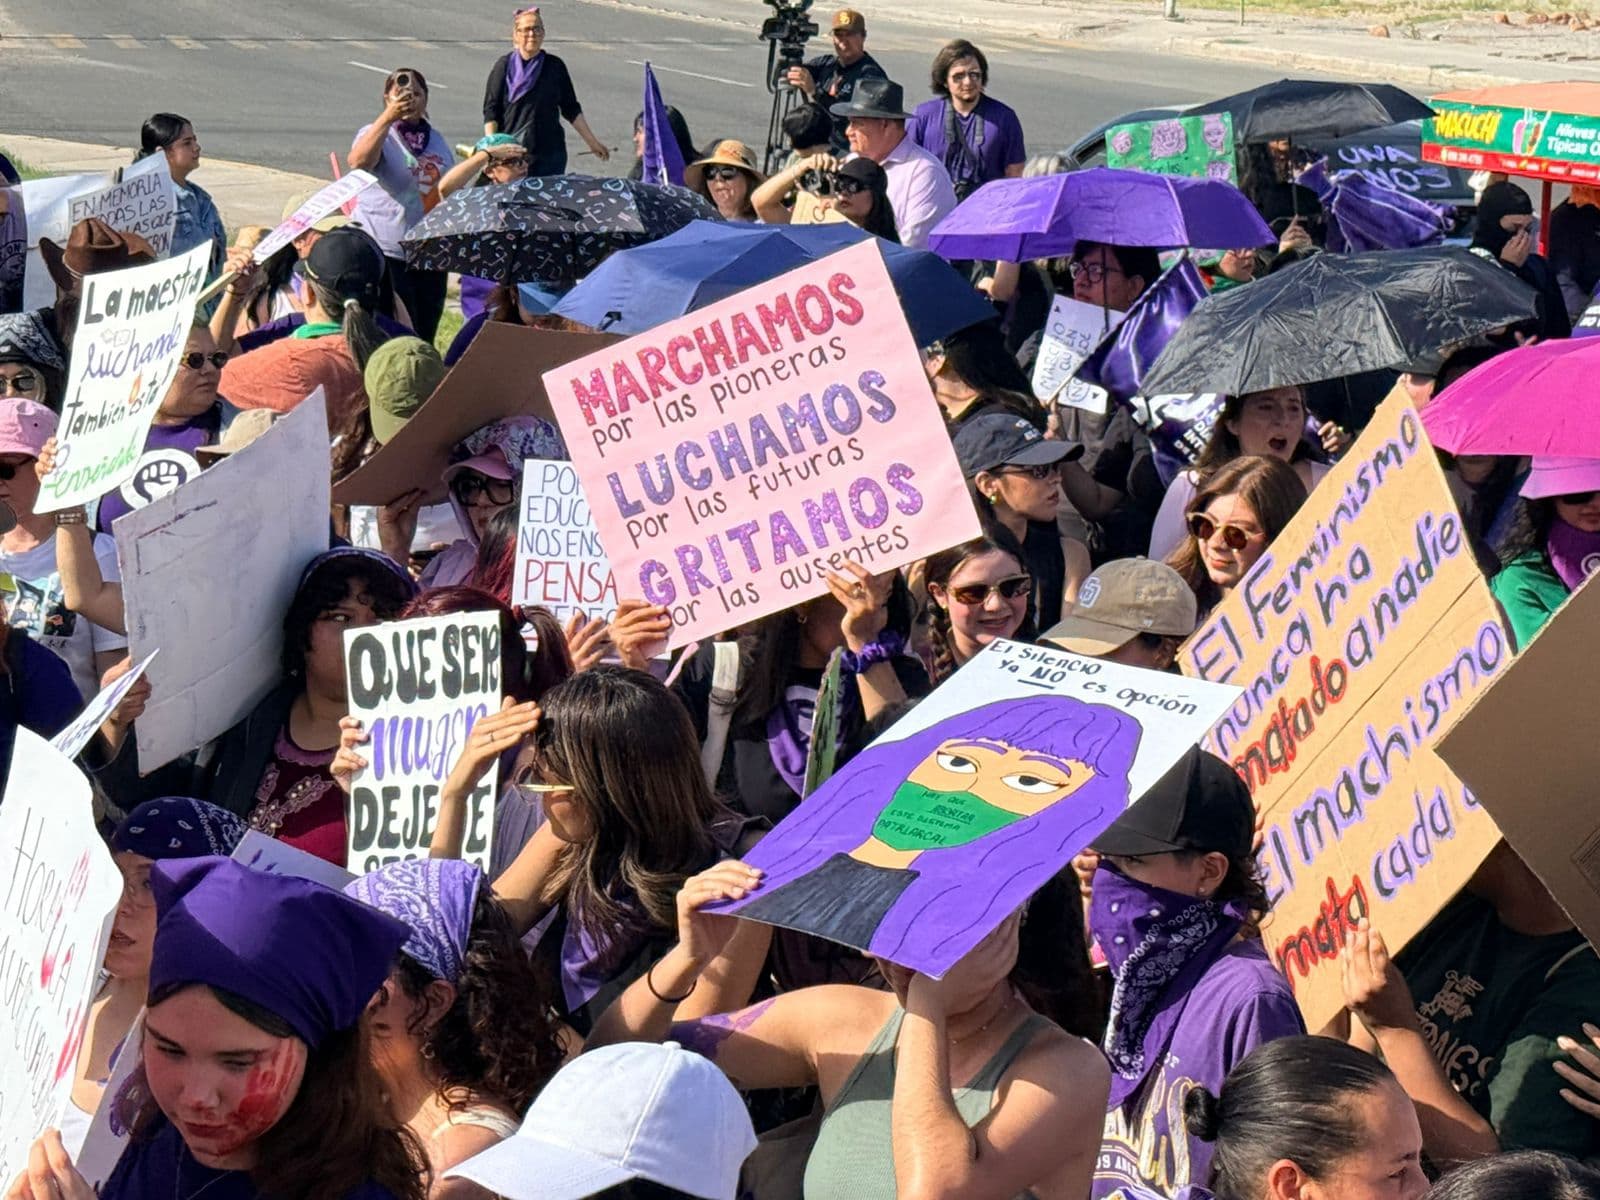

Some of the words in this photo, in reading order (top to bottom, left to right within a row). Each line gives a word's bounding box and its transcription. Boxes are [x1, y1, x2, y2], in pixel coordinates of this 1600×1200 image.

[73, 196, 96, 222] EN
[99, 173, 161, 210] MEMORIA
[1338, 144, 1418, 164] UNA
[139, 195, 167, 216] LAS
[84, 282, 122, 324] La
[127, 257, 203, 320] maestra
[571, 272, 864, 426] MARCHAMOS
[593, 413, 634, 457] por
[652, 393, 698, 428] las
[711, 336, 848, 413] pioneras
[607, 369, 897, 519] LUCHAMOS
[527, 496, 592, 527] EDUC
[627, 515, 669, 550] por
[685, 490, 728, 525] las
[748, 437, 864, 498] futuras
[639, 463, 924, 606] GRITAMOS
[520, 527, 561, 557] NOS
[566, 530, 608, 557] ENS
[669, 600, 701, 628] or
[717, 585, 761, 615] las
[780, 525, 909, 590] ausentes
[1193, 617, 1242, 685] El
[1244, 408, 1420, 641] Feminismo
[350, 628, 437, 709] QUE
[442, 625, 499, 699] SER
[991, 642, 1009, 653] El
[1019, 647, 1102, 675] Silencio
[1031, 666, 1066, 683] NO
[1083, 681, 1107, 694] es
[1214, 612, 1313, 758] nunca
[1315, 549, 1372, 626] ha
[1234, 655, 1347, 793] matado
[1261, 829, 1294, 912] El
[1293, 626, 1504, 863] machismo
[877, 818, 946, 845] PATRIARCAL
[948, 796, 966, 806] QUE
[1270, 876, 1368, 985] mata
[1373, 786, 1452, 899] cada
